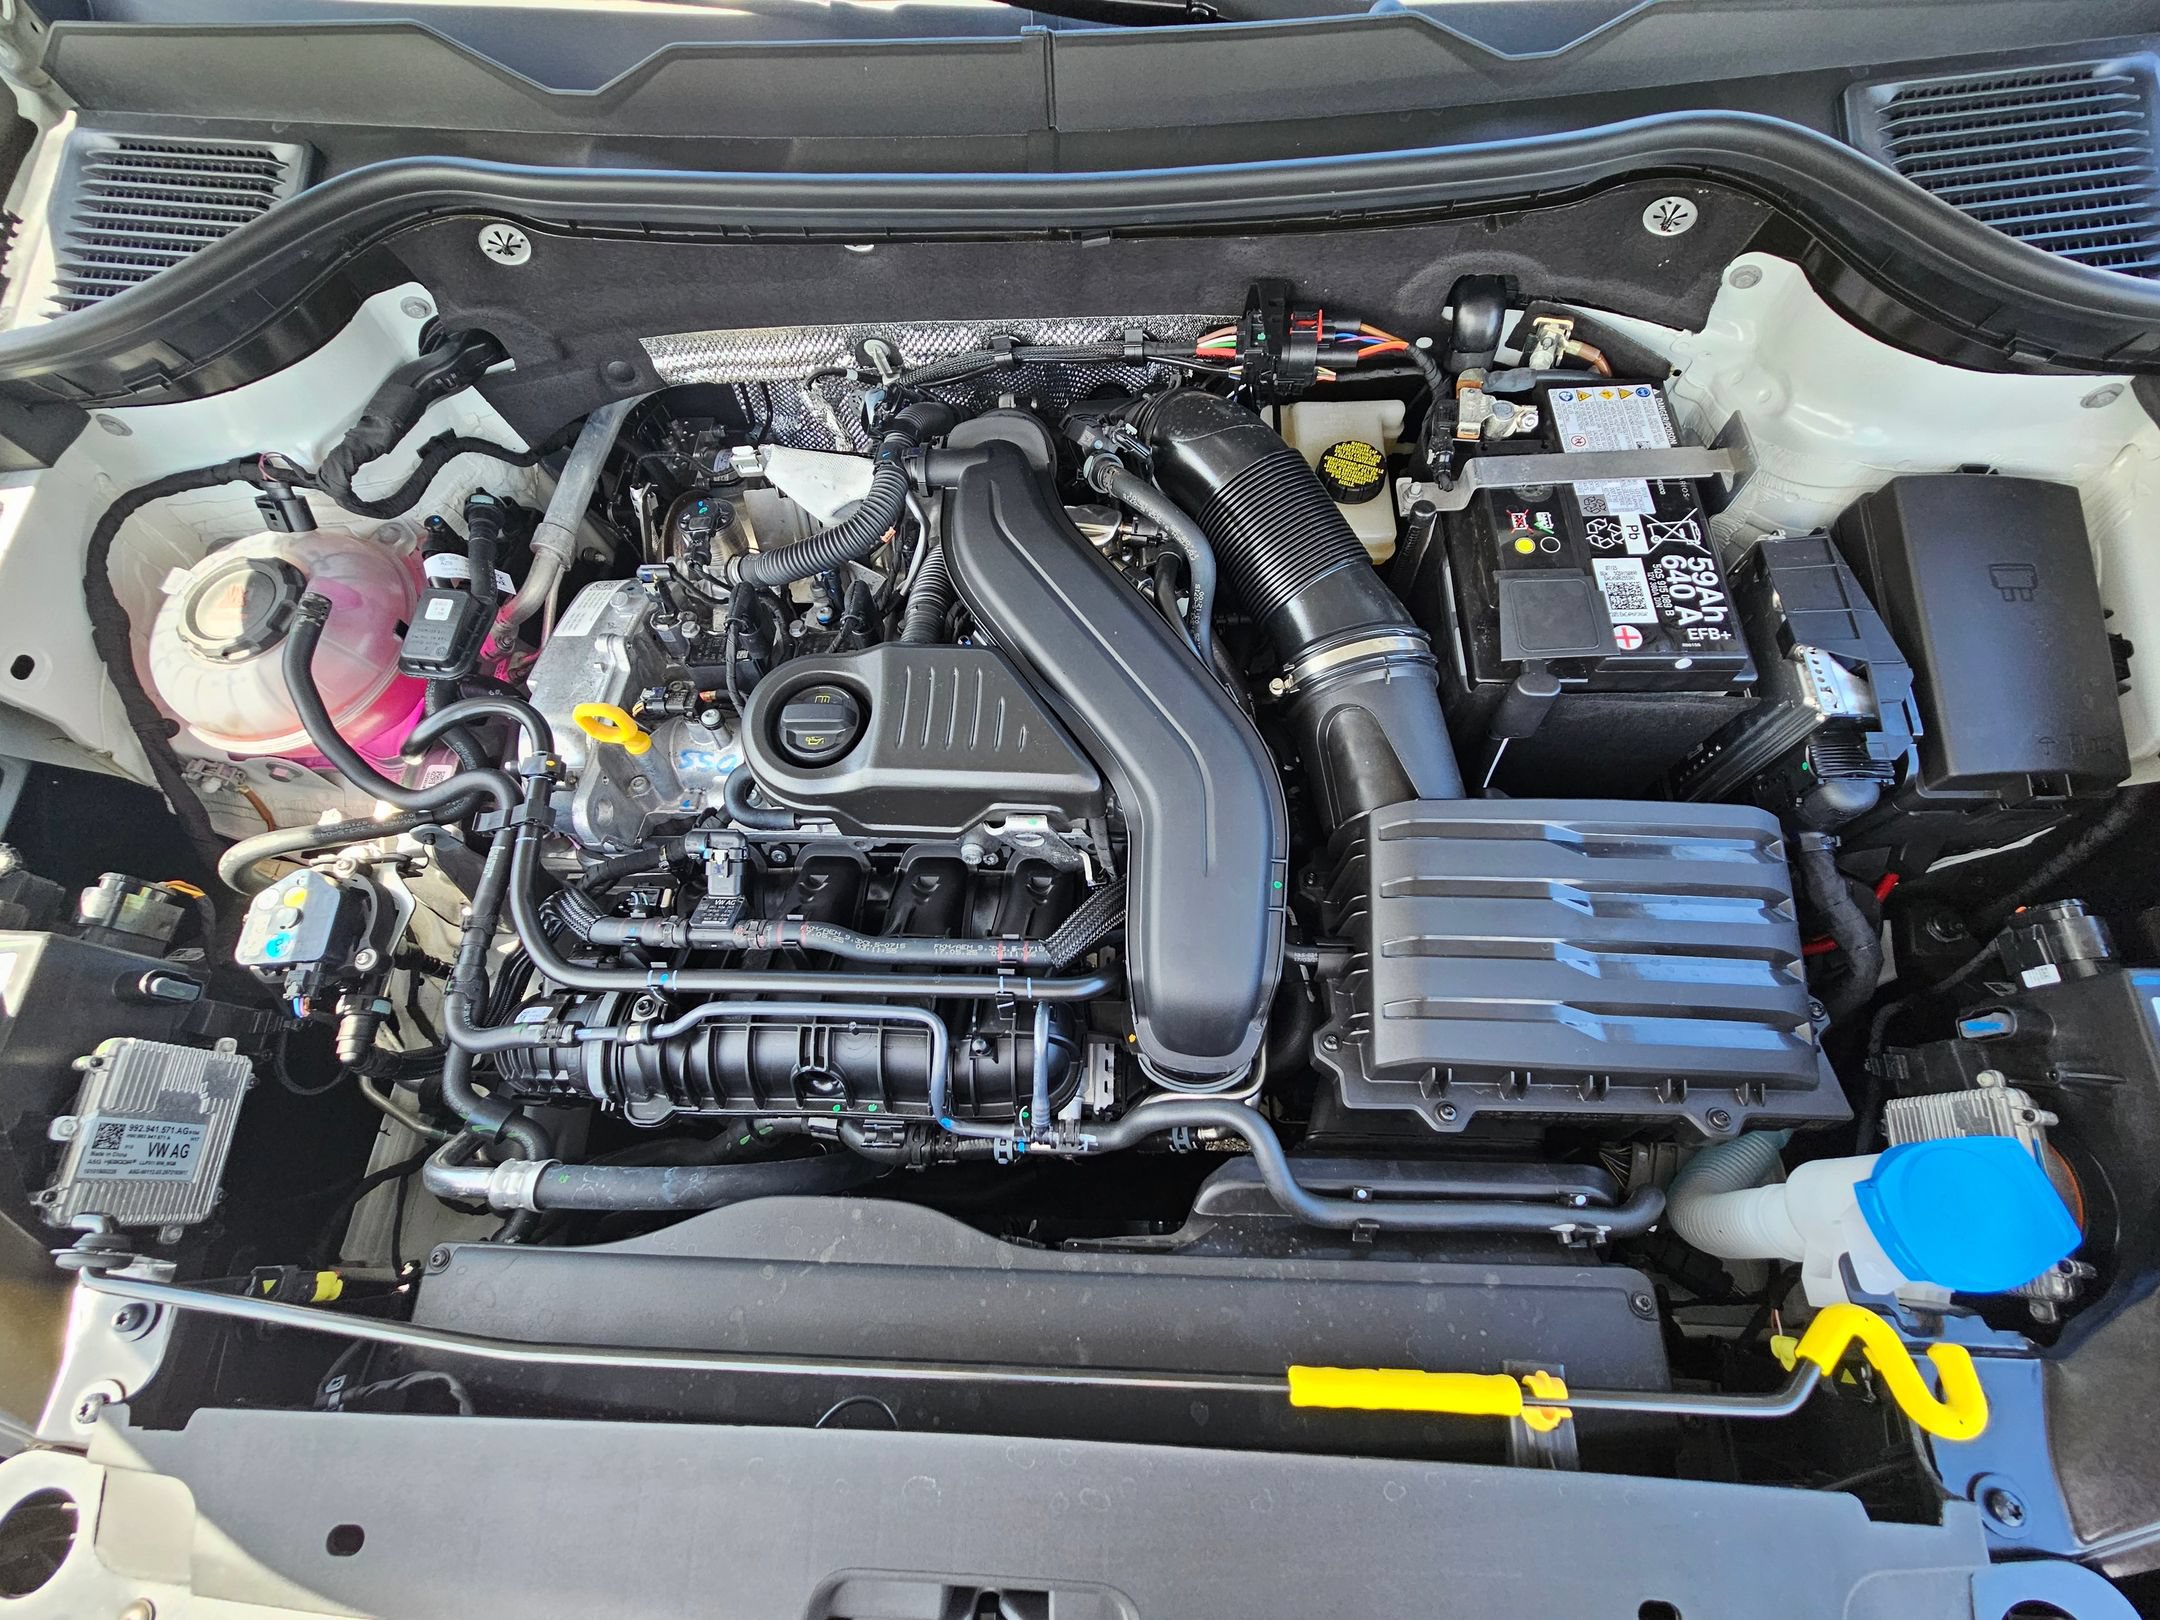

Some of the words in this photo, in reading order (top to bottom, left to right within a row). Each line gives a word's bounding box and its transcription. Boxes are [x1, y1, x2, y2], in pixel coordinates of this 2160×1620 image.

[1655, 397, 1678, 445] DANGER/POISON
[1626, 525, 1639, 540] Pb
[1660, 554, 1696, 600] 640
[1687, 556, 1729, 622] 59Ah
[1657, 580, 1669, 594] 915
[1664, 609, 1675, 617] B
[1674, 605, 1703, 626] A
[1686, 627, 1732, 641] EFB+
[148, 1141, 171, 1158] VW
[169, 1143, 190, 1159] AG
